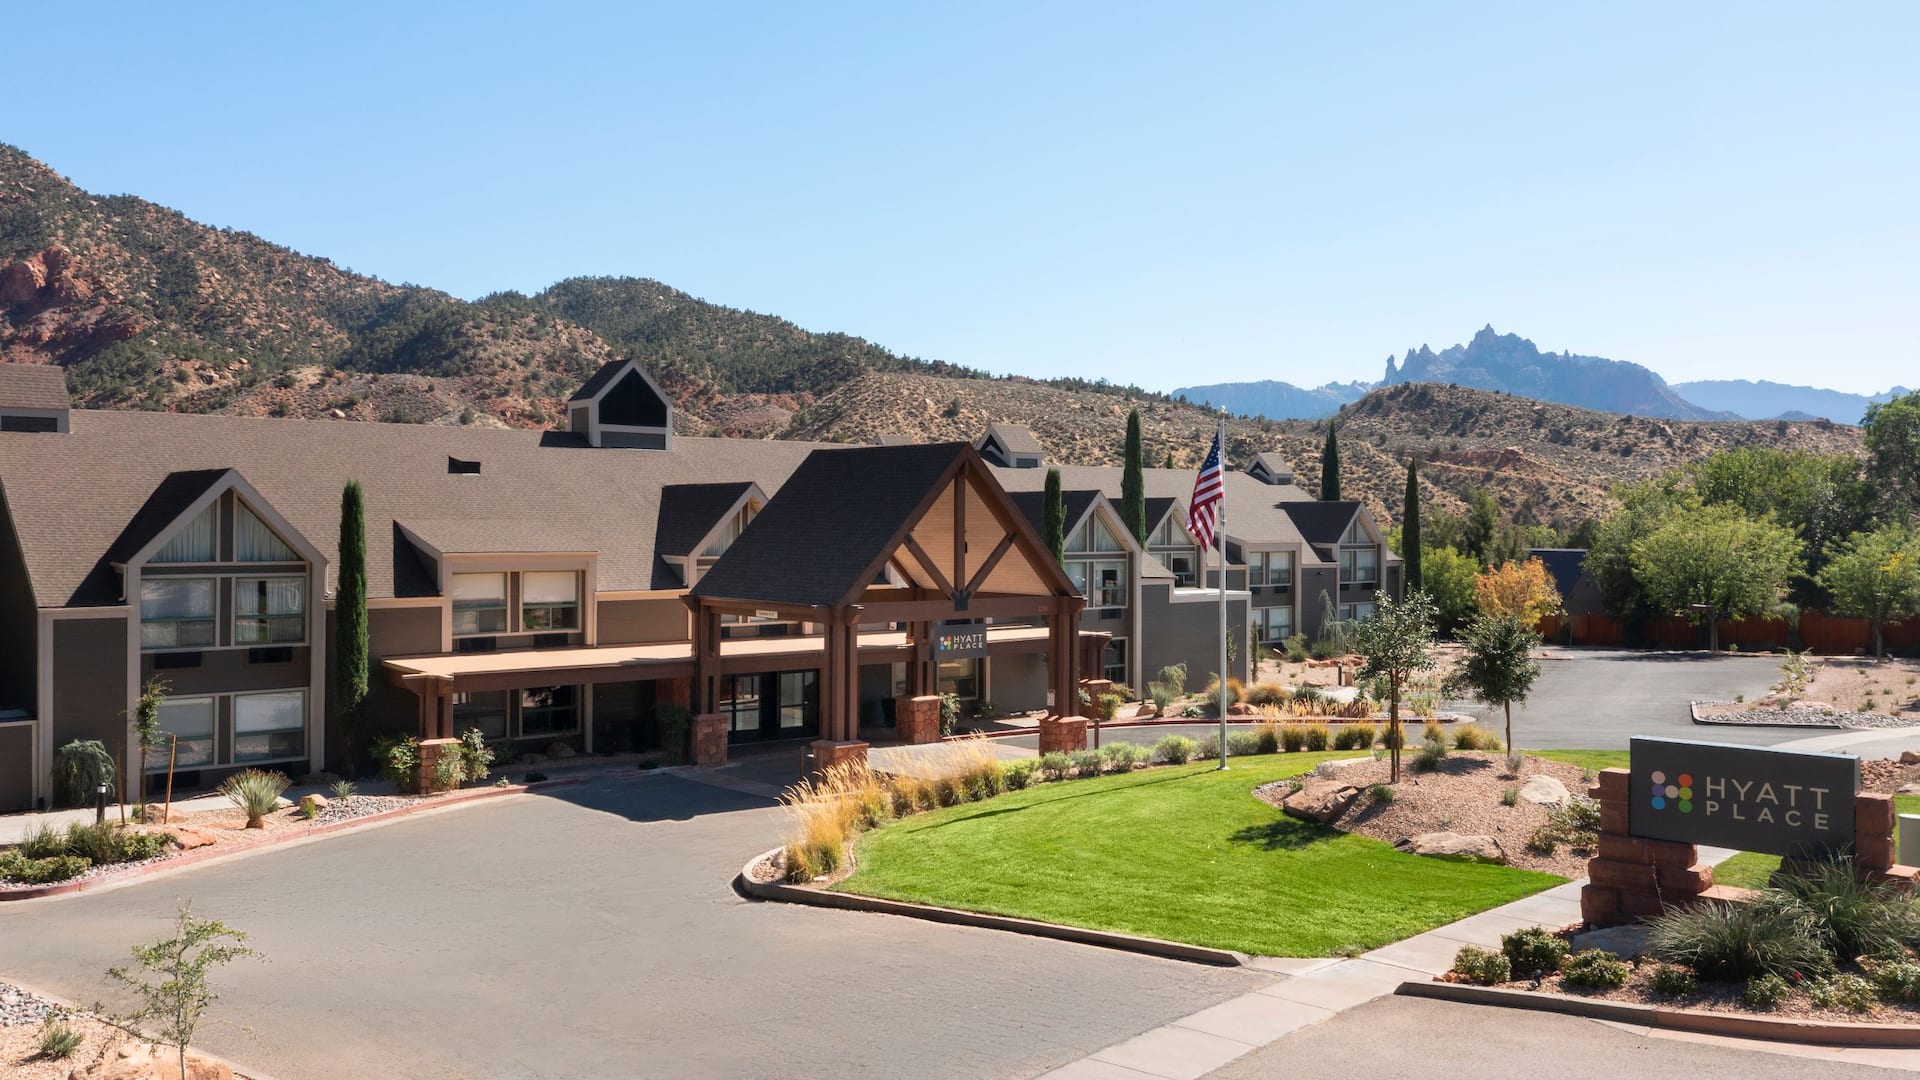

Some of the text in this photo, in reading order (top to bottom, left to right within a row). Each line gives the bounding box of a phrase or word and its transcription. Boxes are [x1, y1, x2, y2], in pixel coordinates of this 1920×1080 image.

[953, 634, 983, 643] HYATT
[1706, 776, 1829, 810] HYATT
[1706, 801, 1829, 830] PLACE
